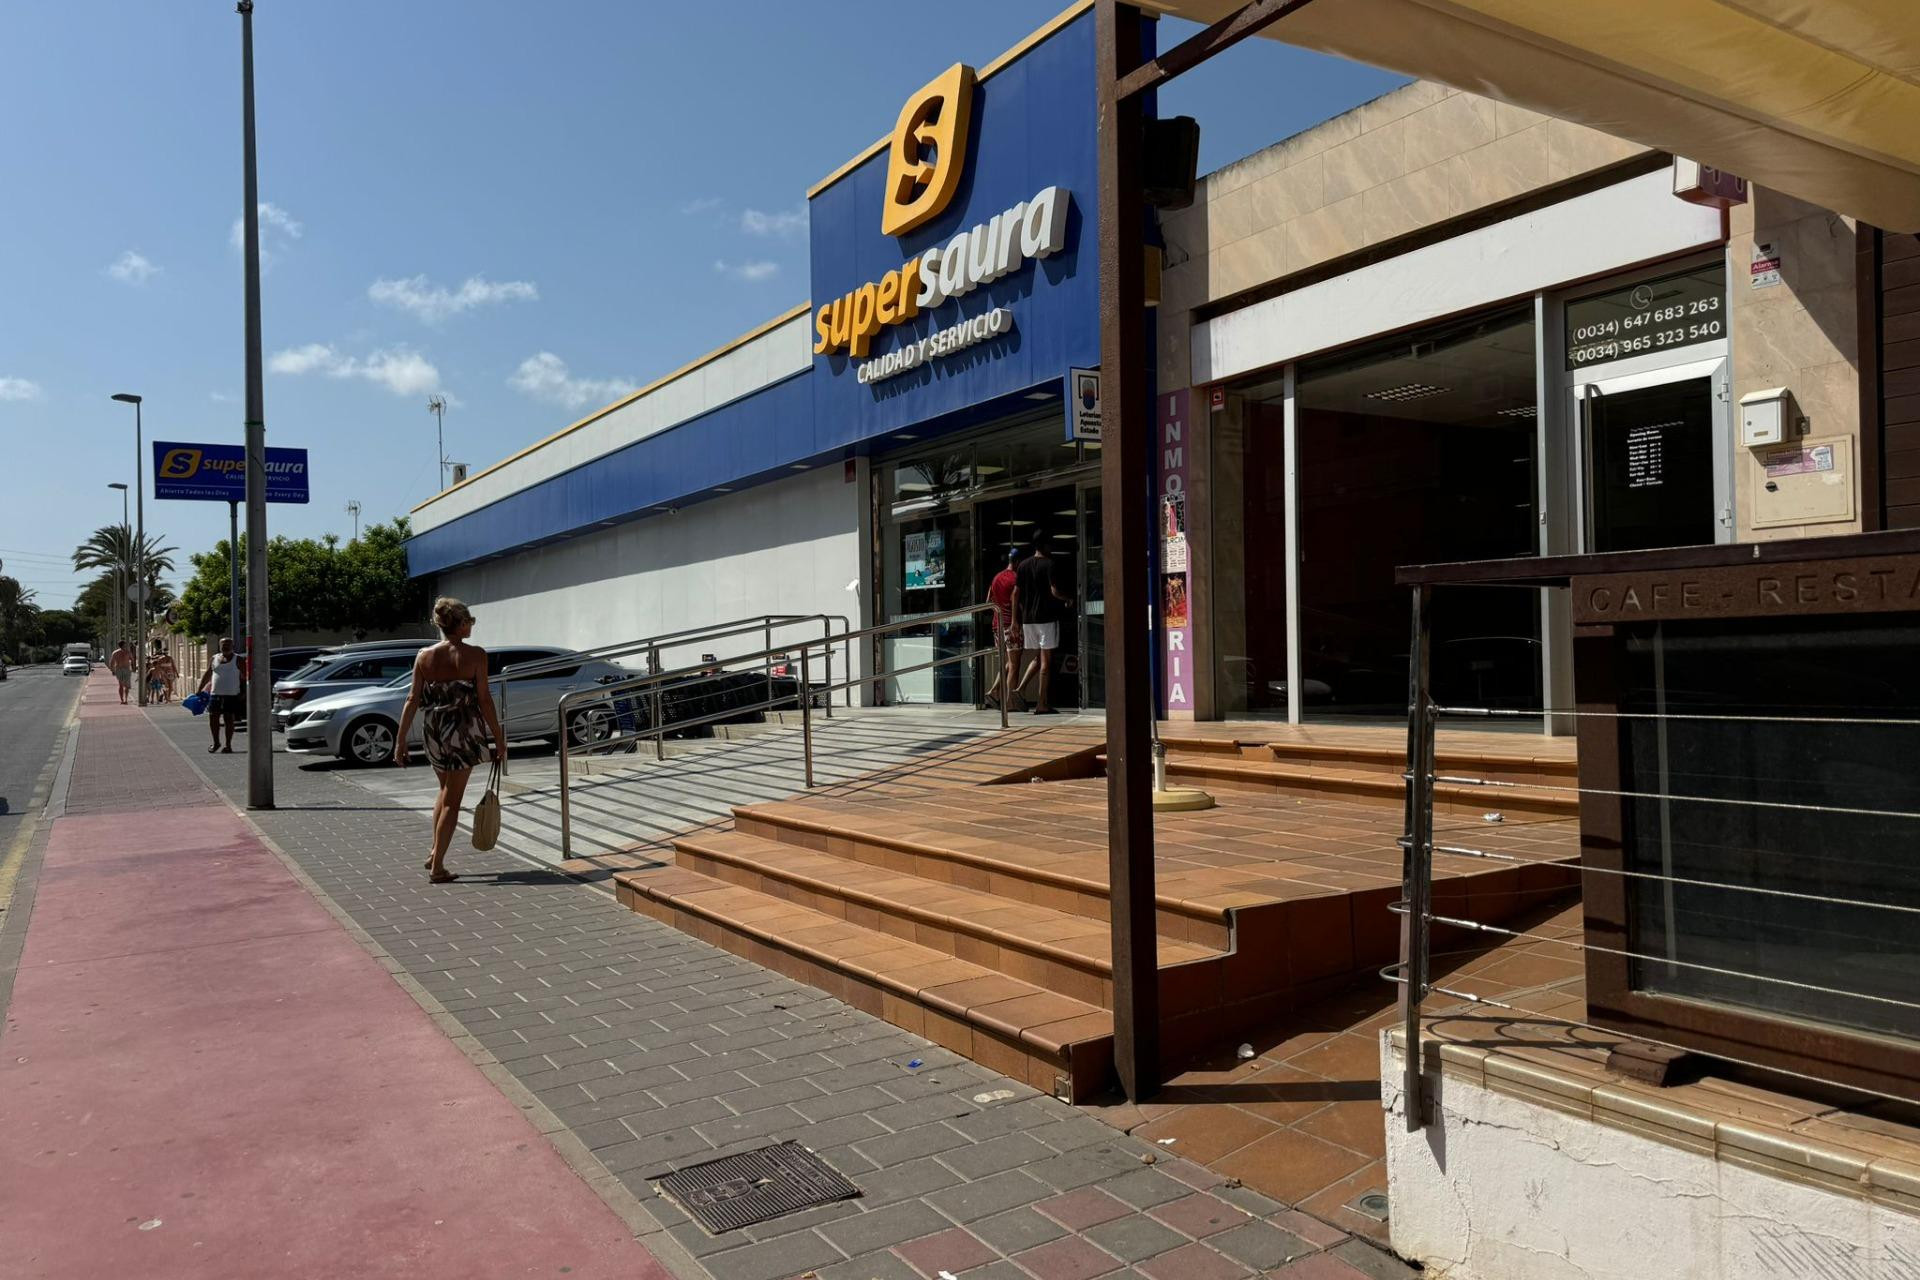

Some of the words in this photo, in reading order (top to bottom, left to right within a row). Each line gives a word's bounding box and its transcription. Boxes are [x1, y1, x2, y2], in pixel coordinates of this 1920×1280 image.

[813, 186, 1068, 358] supersaura
[1572, 319, 1619, 345] (0034)
[1623, 311, 1651, 330] 647
[1654, 304, 1684, 323] 683
[1689, 296, 1719, 315] 263
[1572, 343, 1619, 367] (0034)
[1623, 335, 1651, 353] 965
[1656, 328, 1684, 346] 323
[1689, 320, 1720, 339] 540
[857, 345, 917, 384] CALIDAD
[918, 339, 932, 361] Y
[929, 307, 1010, 357] SERVICIO
[1588, 581, 1701, 613] CAFE
